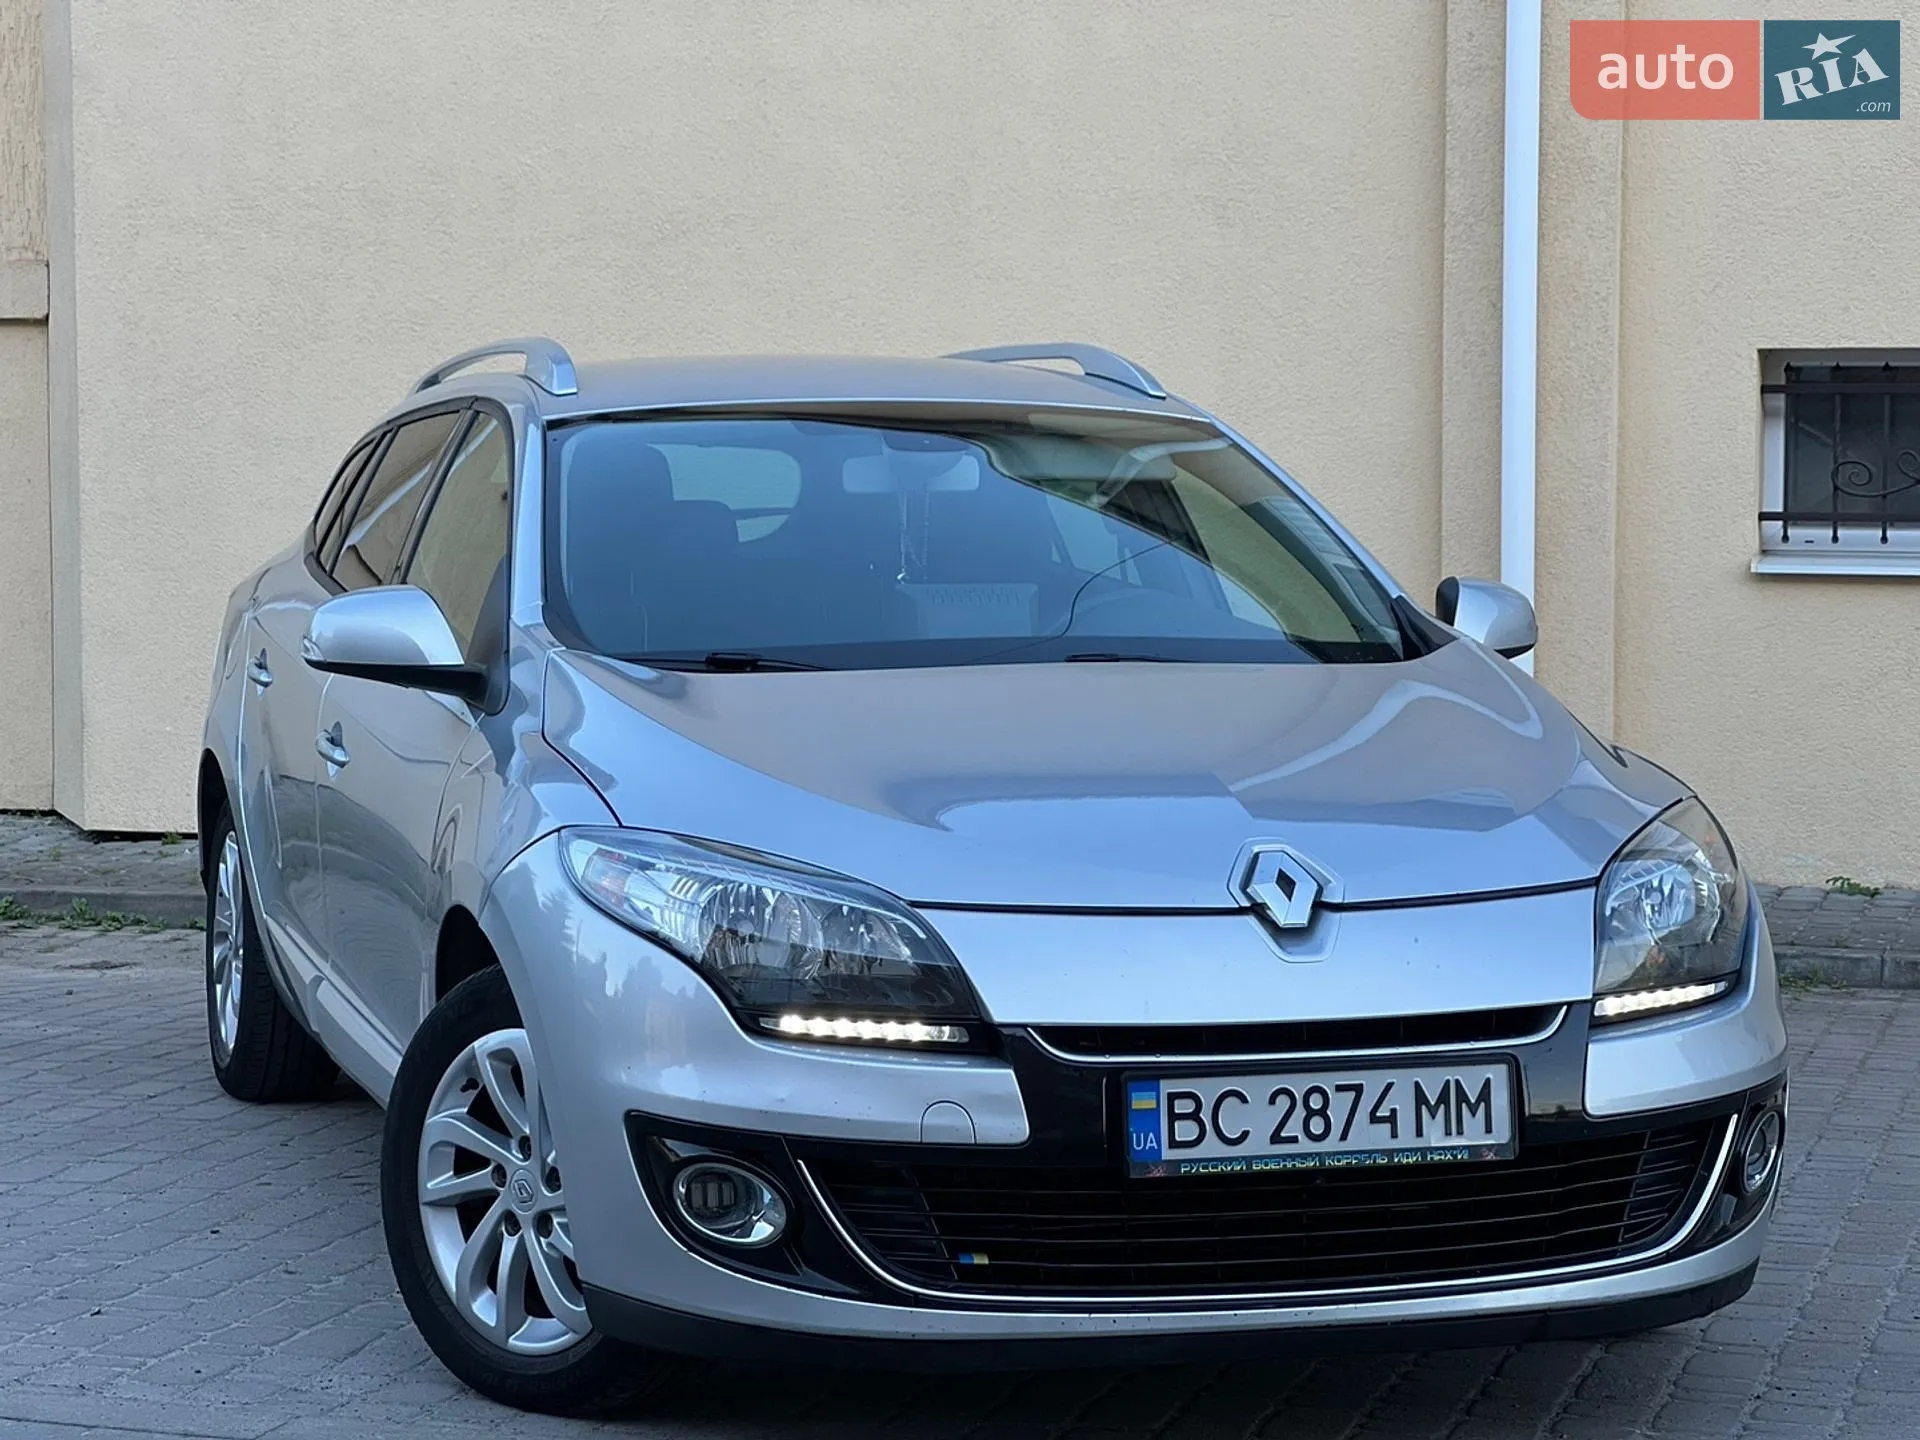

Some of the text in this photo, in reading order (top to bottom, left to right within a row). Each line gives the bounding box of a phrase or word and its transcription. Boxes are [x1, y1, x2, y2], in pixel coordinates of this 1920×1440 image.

[1166, 1075, 1493, 1149] BC 2874 MM
[1132, 1132, 1158, 1151] UA
[1180, 1157, 1246, 1174] РУССКИЙ
[1252, 1154, 1319, 1170] ВОЕННЫЙ
[1393, 1150, 1422, 1164] ИДИ
